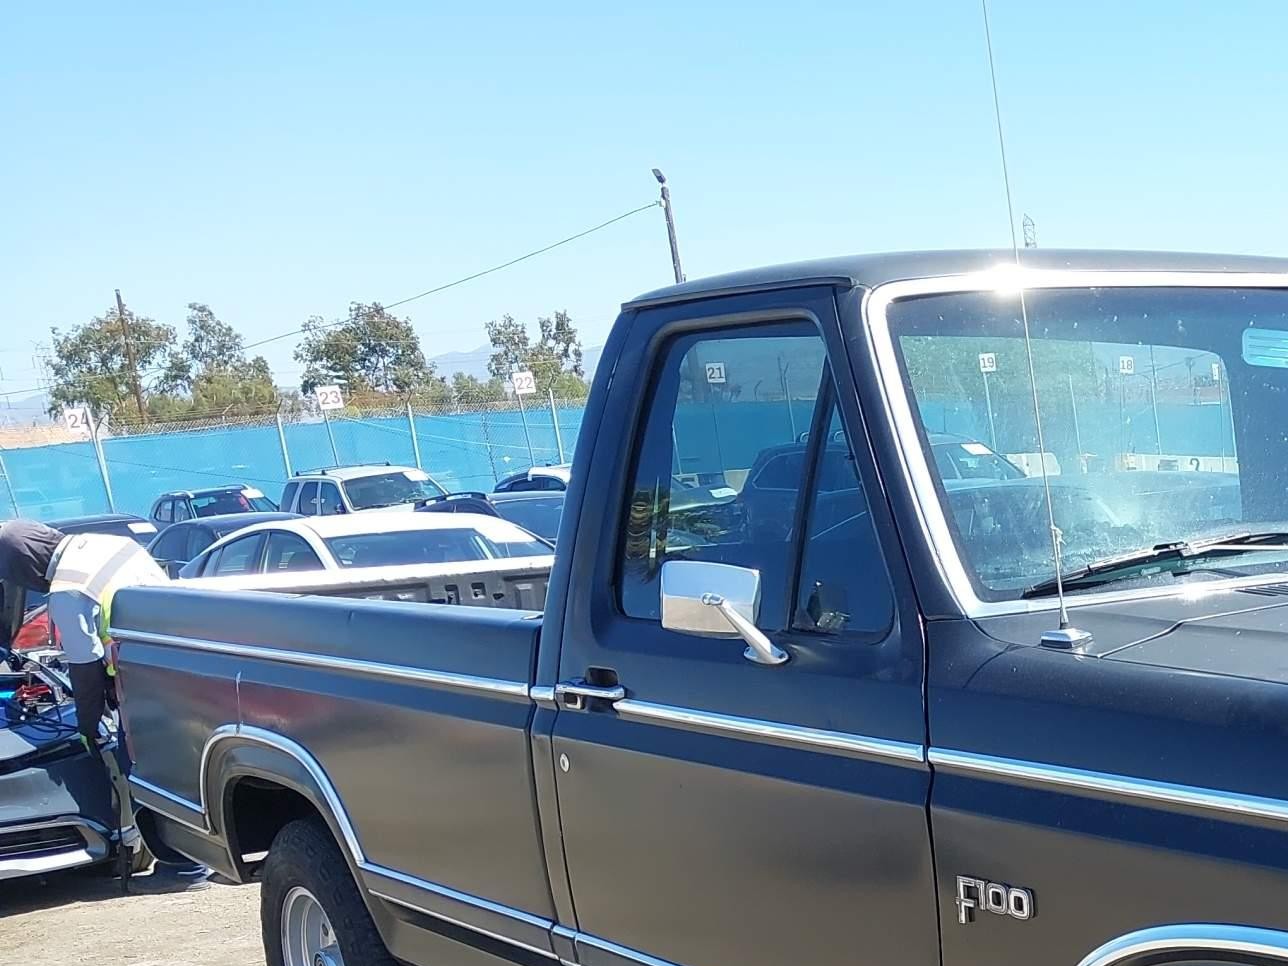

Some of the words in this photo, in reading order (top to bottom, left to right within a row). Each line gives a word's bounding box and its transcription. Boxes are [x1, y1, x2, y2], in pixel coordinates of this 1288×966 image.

[707, 366, 725, 380] 21
[515, 376, 533, 390] 22
[319, 390, 341, 405] 23
[955, 875, 1034, 924] F100
